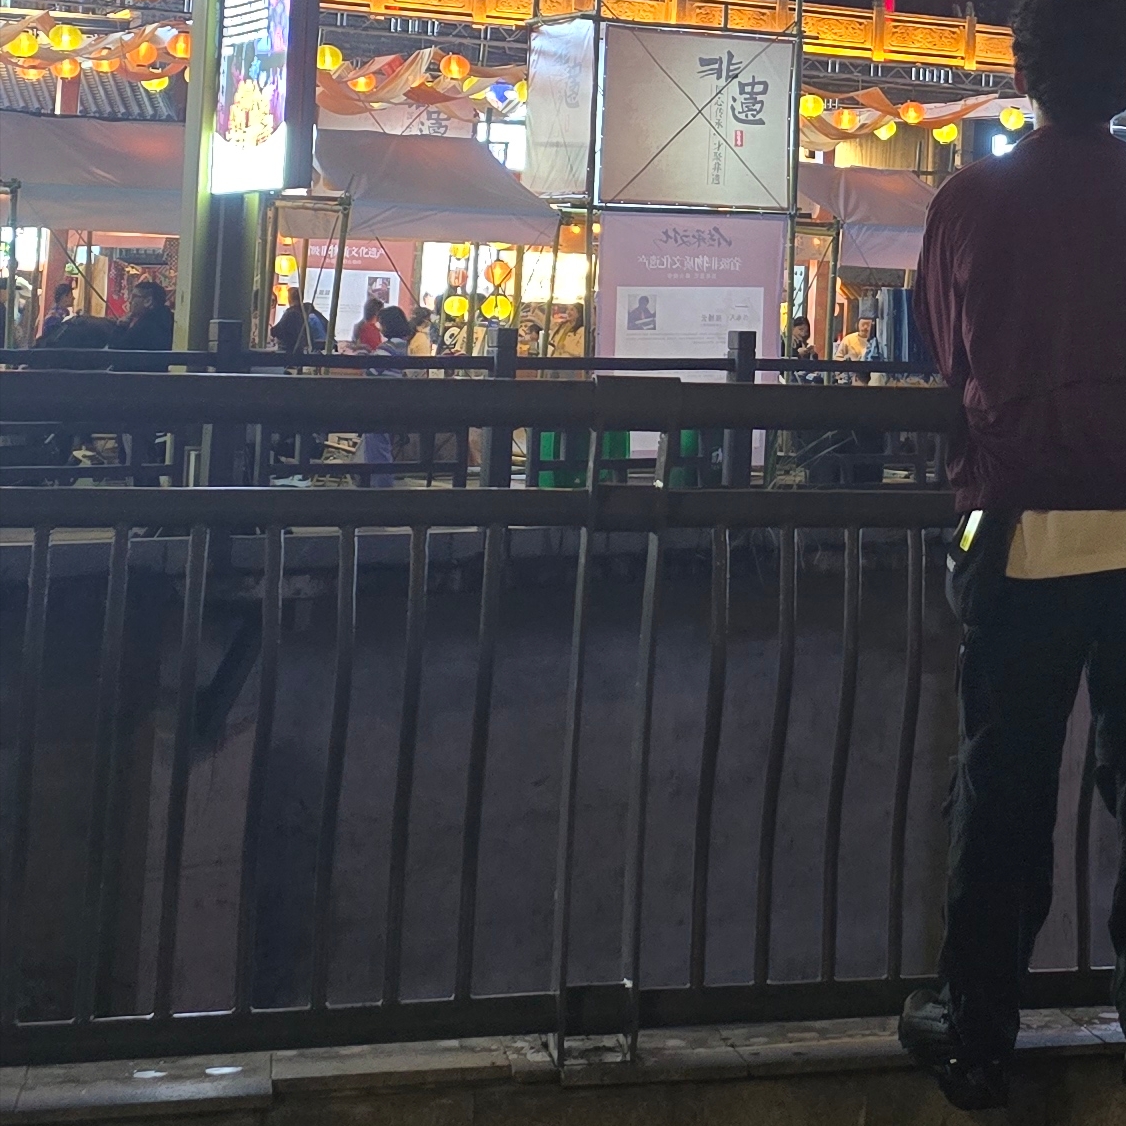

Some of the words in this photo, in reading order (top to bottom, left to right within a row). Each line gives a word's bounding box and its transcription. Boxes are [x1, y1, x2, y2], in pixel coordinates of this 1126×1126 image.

[696, 49, 769, 126] 非遗
[307, 244, 386, 260] 级非物文化遗产
